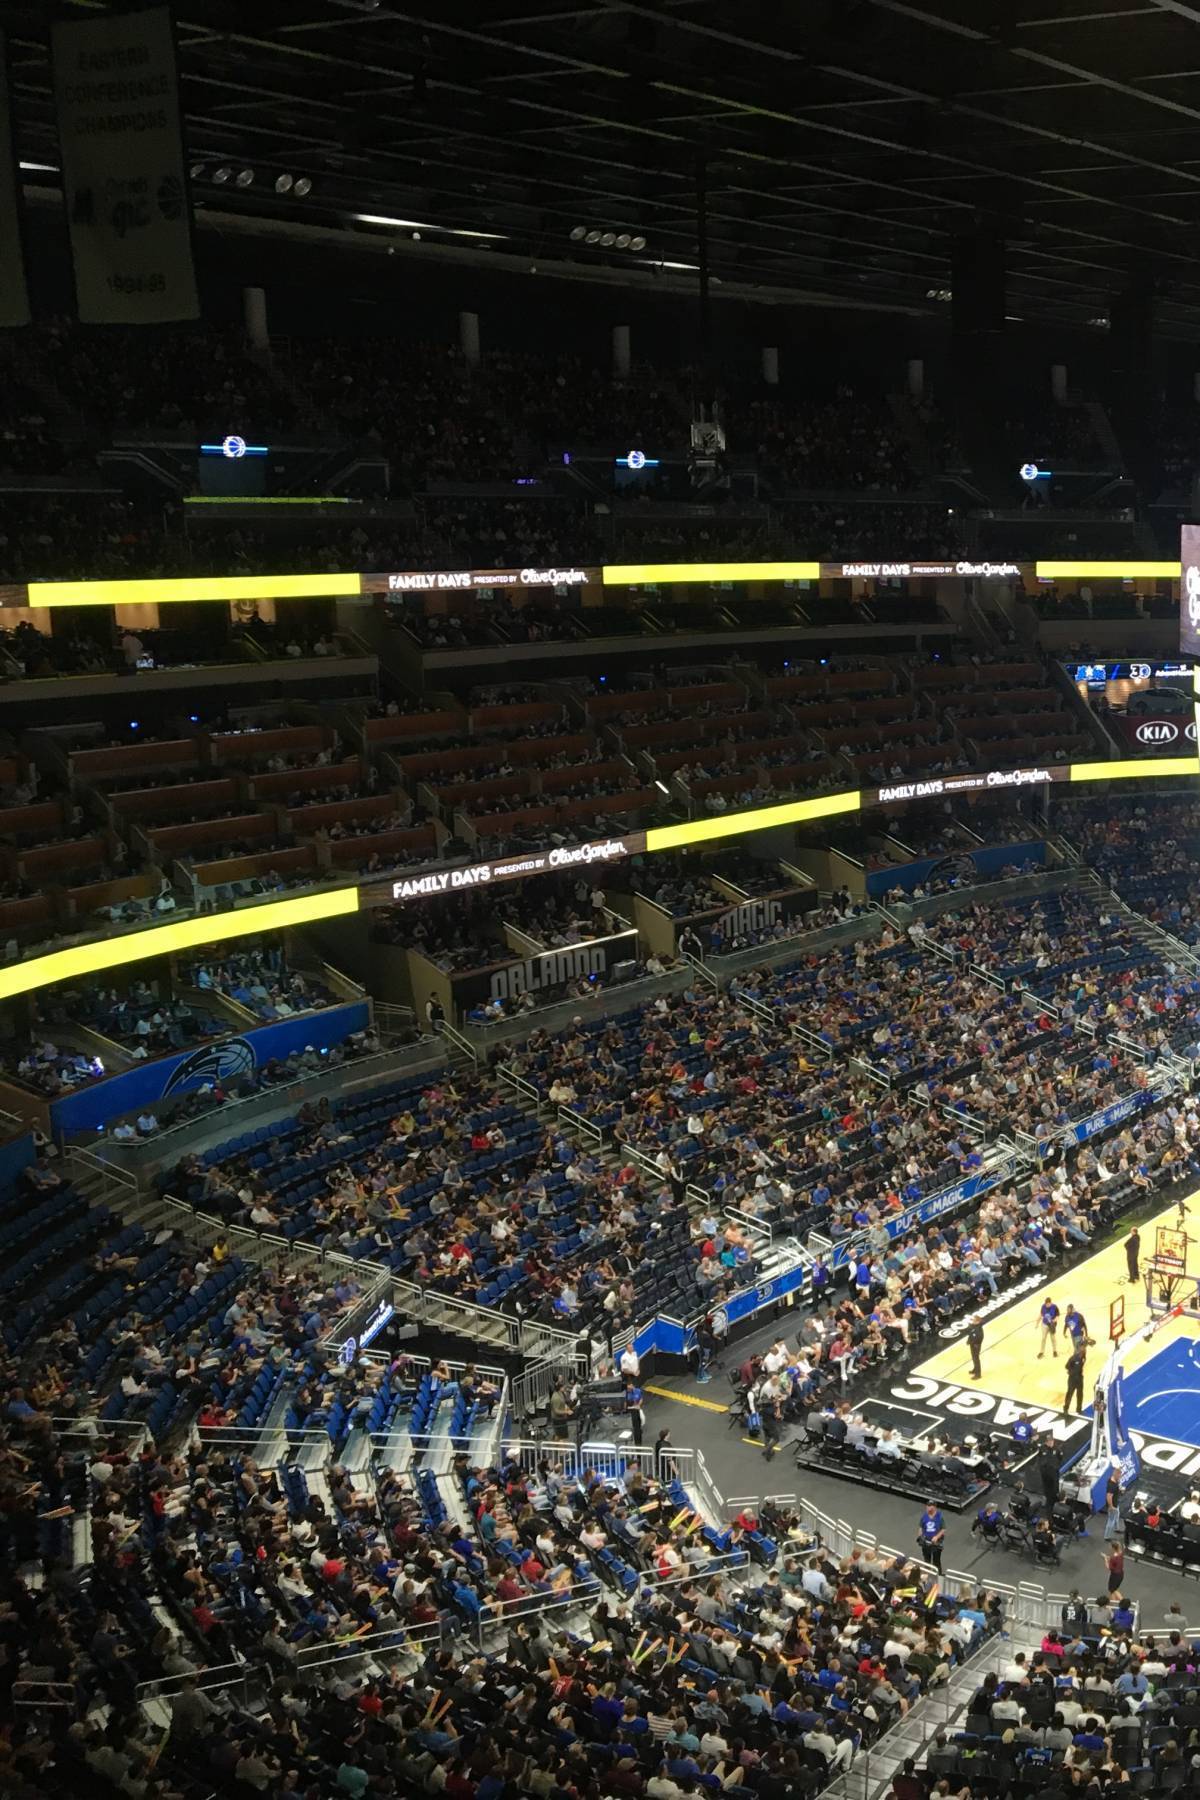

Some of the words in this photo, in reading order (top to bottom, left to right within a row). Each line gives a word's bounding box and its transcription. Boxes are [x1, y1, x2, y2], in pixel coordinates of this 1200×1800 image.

[79, 46, 150, 72] EASTERN
[65, 75, 170, 104] CONFERENCE
[73, 109, 167, 137] CHAMPIONS
[389, 575, 436, 589] FAMILY
[438, 573, 472, 588] DAYS
[474, 575, 509, 585] PRESENTED
[510, 575, 518, 583] BY
[842, 564, 882, 576] FAMILY
[882, 564, 911, 576] DAYS
[913, 566, 945, 574] PRESENTED
[1143, 726, 1171, 740] KIA
[879, 774, 917, 801] FAMILY
[917, 781, 944, 796] DAYS
[945, 780, 976, 789] PRESENTED
[977, 778, 984, 786] BY
[393, 865, 451, 899] FAMILY
[451, 866, 491, 887] DAYS
[494, 861, 534, 876] PRESENTED
[535, 859, 545, 869] BY
[719, 899, 783, 938] MAGIC
[490, 947, 606, 1000] ORLANDO
[1085, 1115, 1106, 1135] PURE
[932, 1188, 965, 1214] MAGIC
[891, 1376, 1090, 1442] MAGIC
